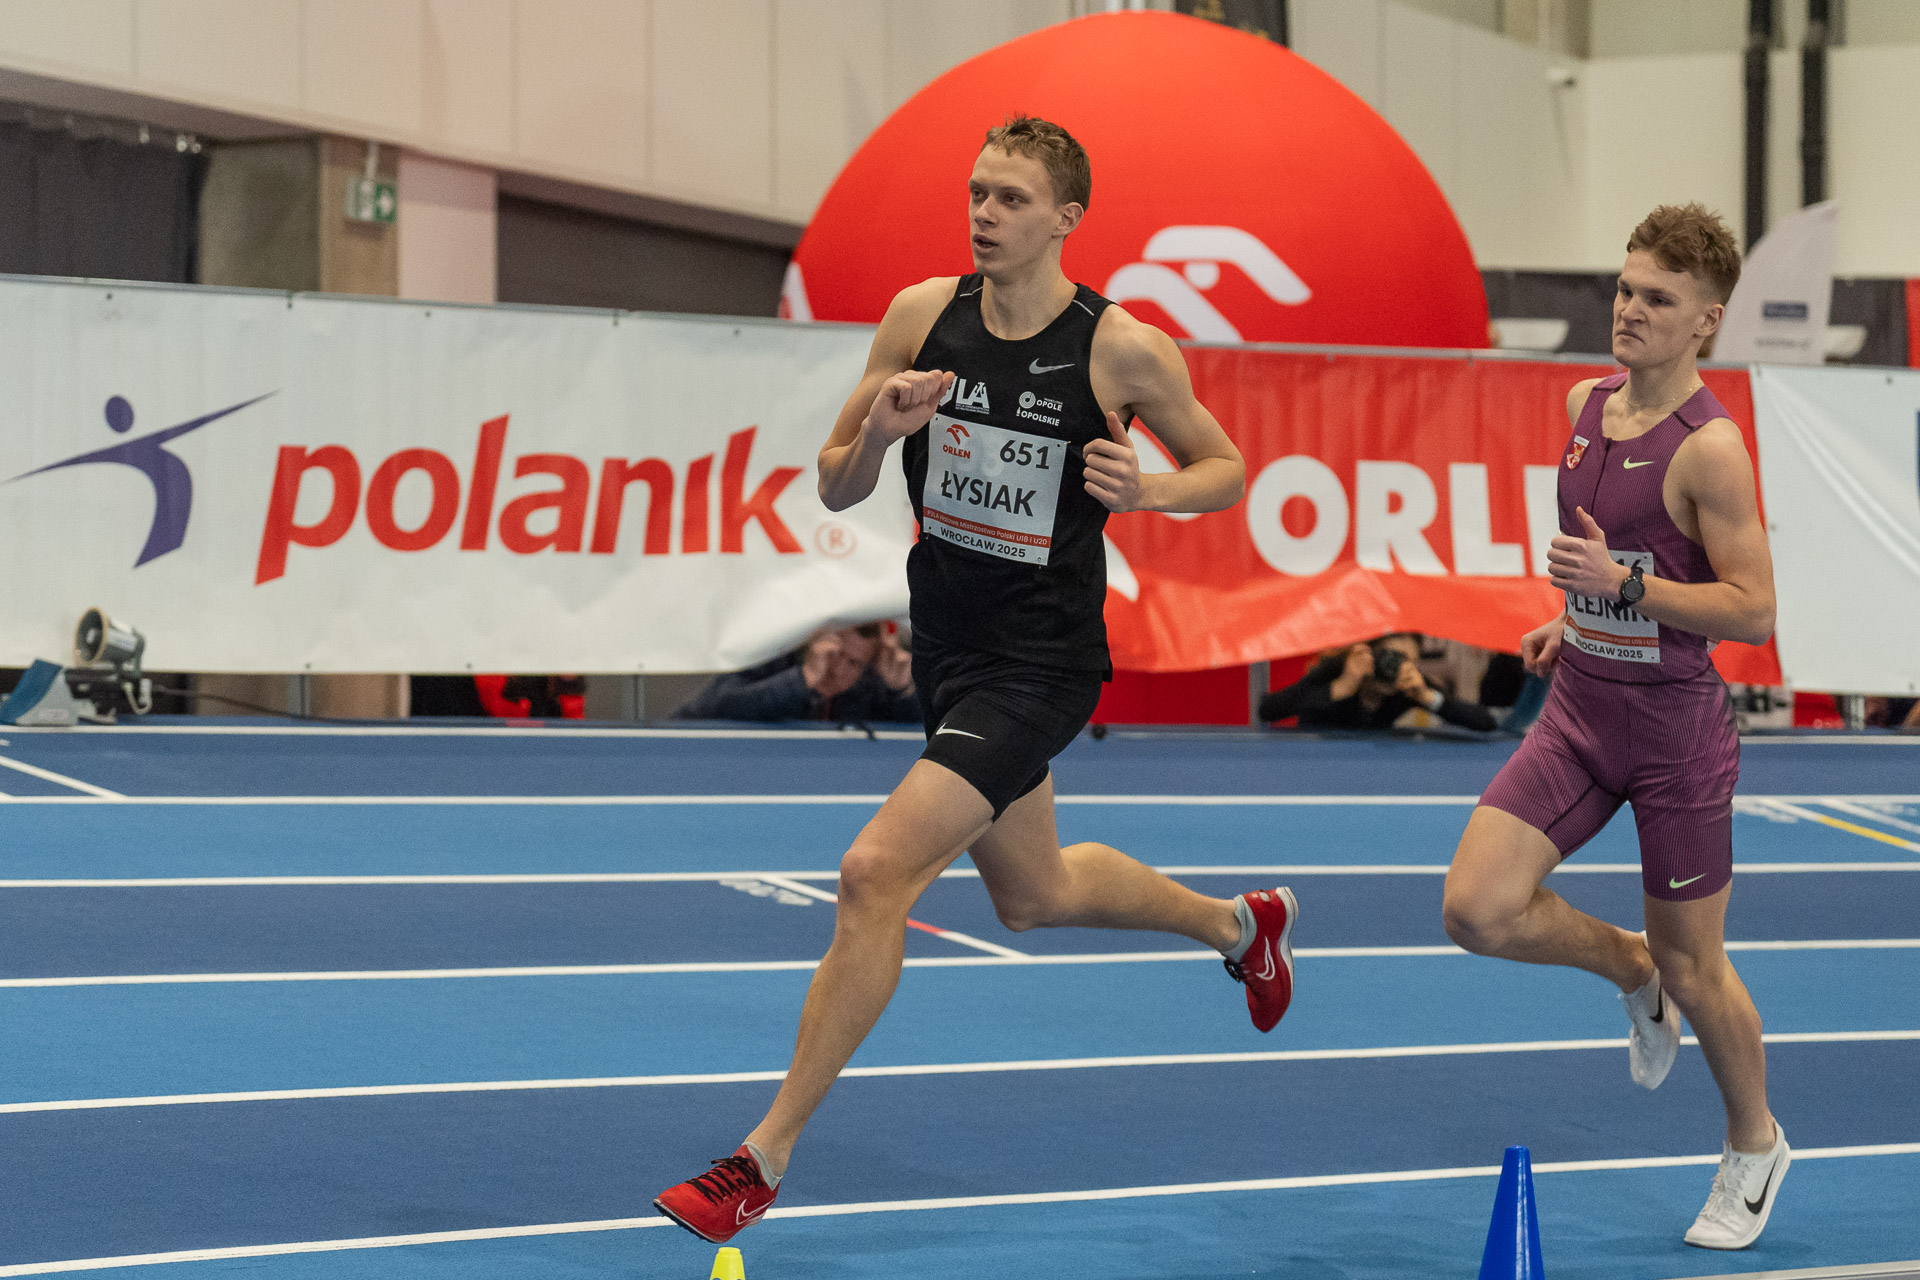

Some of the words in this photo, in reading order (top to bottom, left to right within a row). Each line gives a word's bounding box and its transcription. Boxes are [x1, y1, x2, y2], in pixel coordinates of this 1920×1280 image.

[1036, 399, 1063, 412] OPOLE
[1020, 410, 1060, 427] OPOLSKIE
[942, 444, 971, 460] ORLEN
[999, 439, 1050, 470] 651
[940, 469, 1038, 518] ŁYSIAK
[1247, 455, 1560, 578] ORL
[940, 526, 995, 551] WROCŁAW
[997, 543, 1027, 558] 2025
[959, 521, 996, 537] Mistrzostwa
[996, 530, 1015, 542] Polski
[1016, 535, 1029, 544] U18
[1033, 537, 1048, 546] U20
[1617, 649, 1644, 659] 2025
